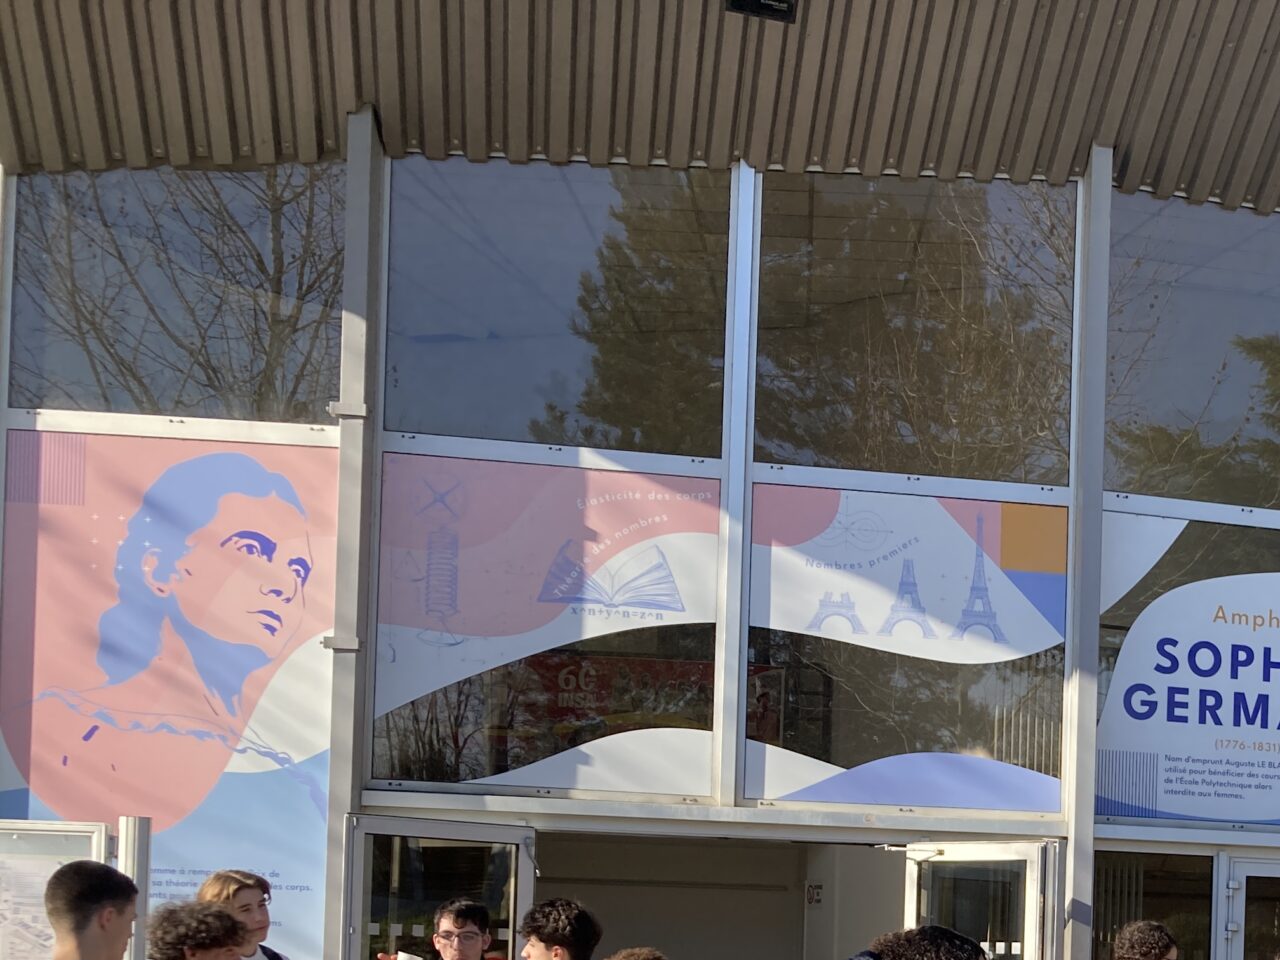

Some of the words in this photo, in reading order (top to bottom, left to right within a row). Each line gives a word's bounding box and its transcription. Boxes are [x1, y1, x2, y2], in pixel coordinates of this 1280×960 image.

[576, 490, 641, 510] Élasticité
[648, 490, 670, 501] des
[676, 492, 712, 502] corps
[553, 556, 591, 598] Théorie
[591, 536, 611, 555] des
[615, 513, 668, 539] nombres
[805, 557, 863, 570] Nombres
[869, 536, 920, 568] premiers
[1214, 738, 1280, 754] (1776-1831)
[1164, 754, 1183, 763] Nom
[1184, 755, 1223, 766] d'emprunt
[1225, 758, 1256, 768] Auguste
[1257, 760, 1266, 768] LE
[1164, 766, 1187, 774] utilisé
[1189, 768, 1207, 776] pour
[1208, 766, 1244, 778] bénéficier
[1246, 770, 1259, 779] des
[1164, 776, 1174, 784] de
[1175, 776, 1200, 785] l'École
[1201, 778, 1252, 790] Polytechnique
[1254, 781, 1273, 790] alors
[1164, 787, 1196, 797] interdite
[1213, 790, 1246, 800] femmes.
[268, 869, 281, 878] de
[285, 884, 313, 892] corps.
